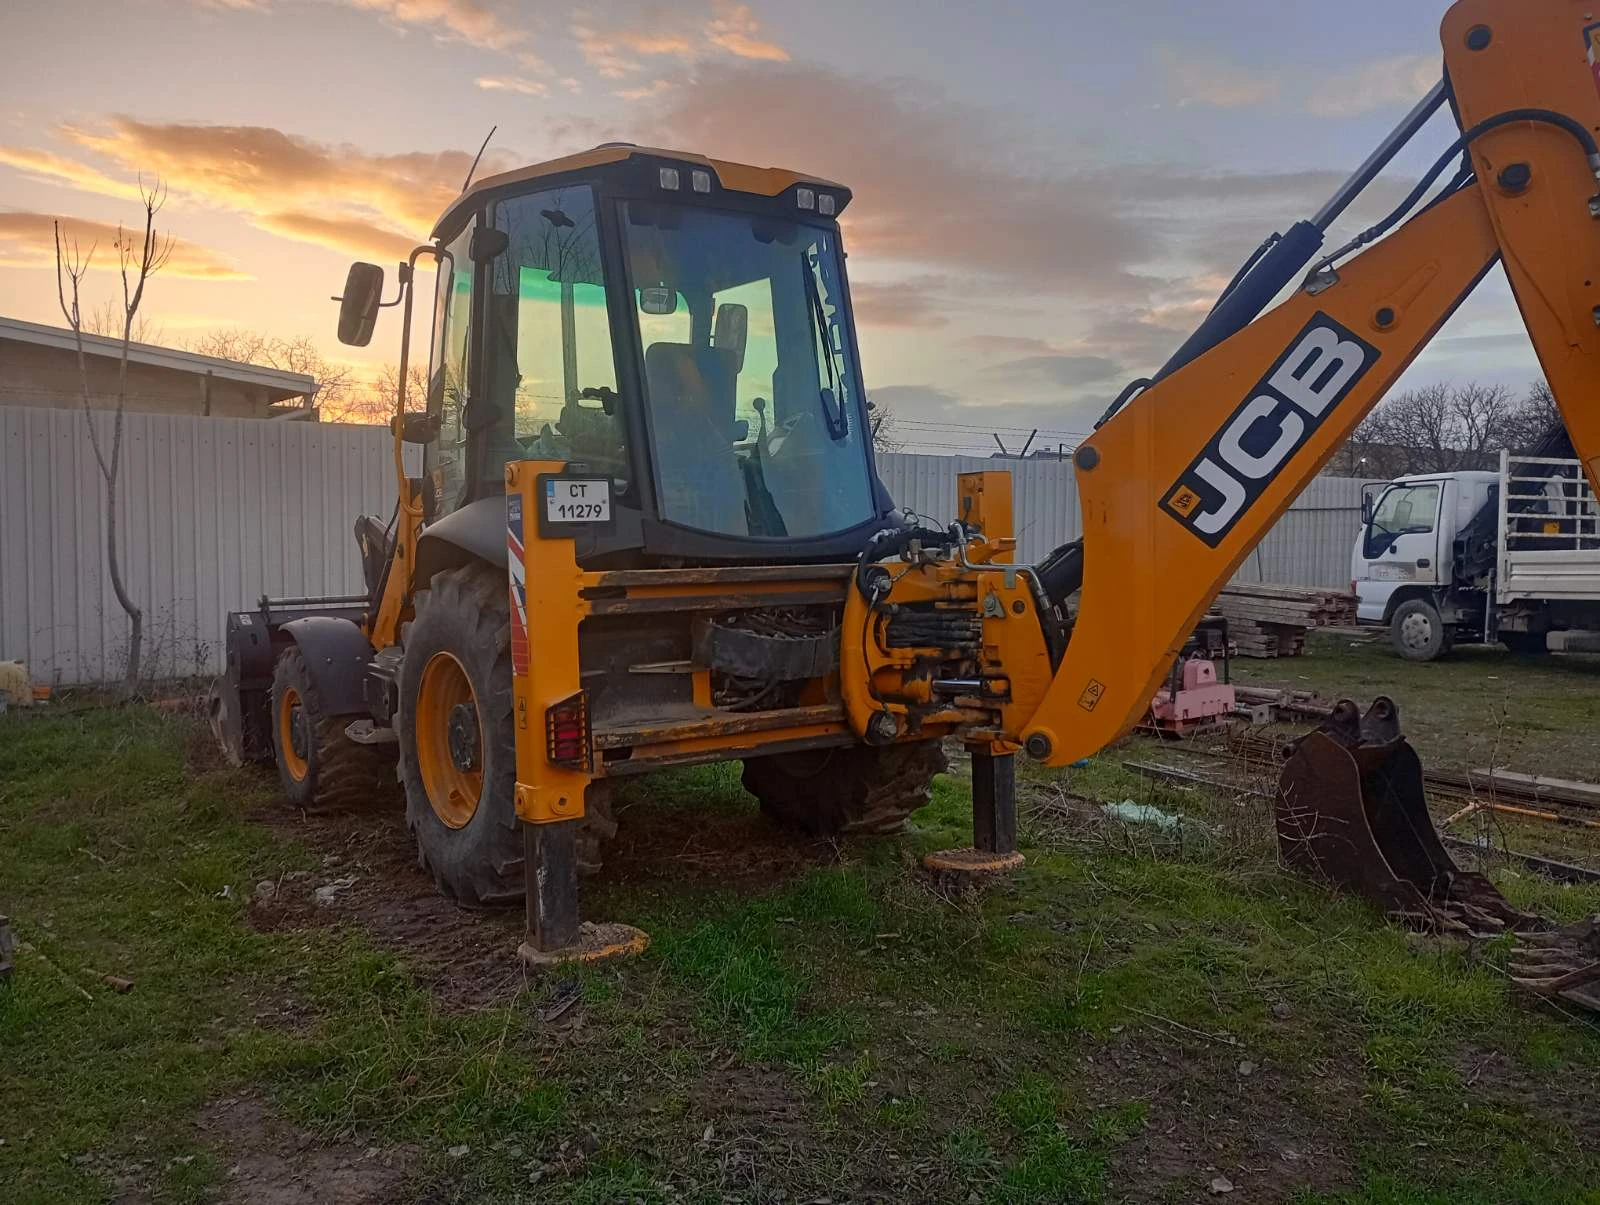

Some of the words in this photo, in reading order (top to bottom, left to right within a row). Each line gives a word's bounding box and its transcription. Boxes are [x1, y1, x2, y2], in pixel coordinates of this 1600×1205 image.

[1192, 326, 1365, 534] JCB
[569, 484, 588, 498] CT
[558, 504, 602, 519] 11279
